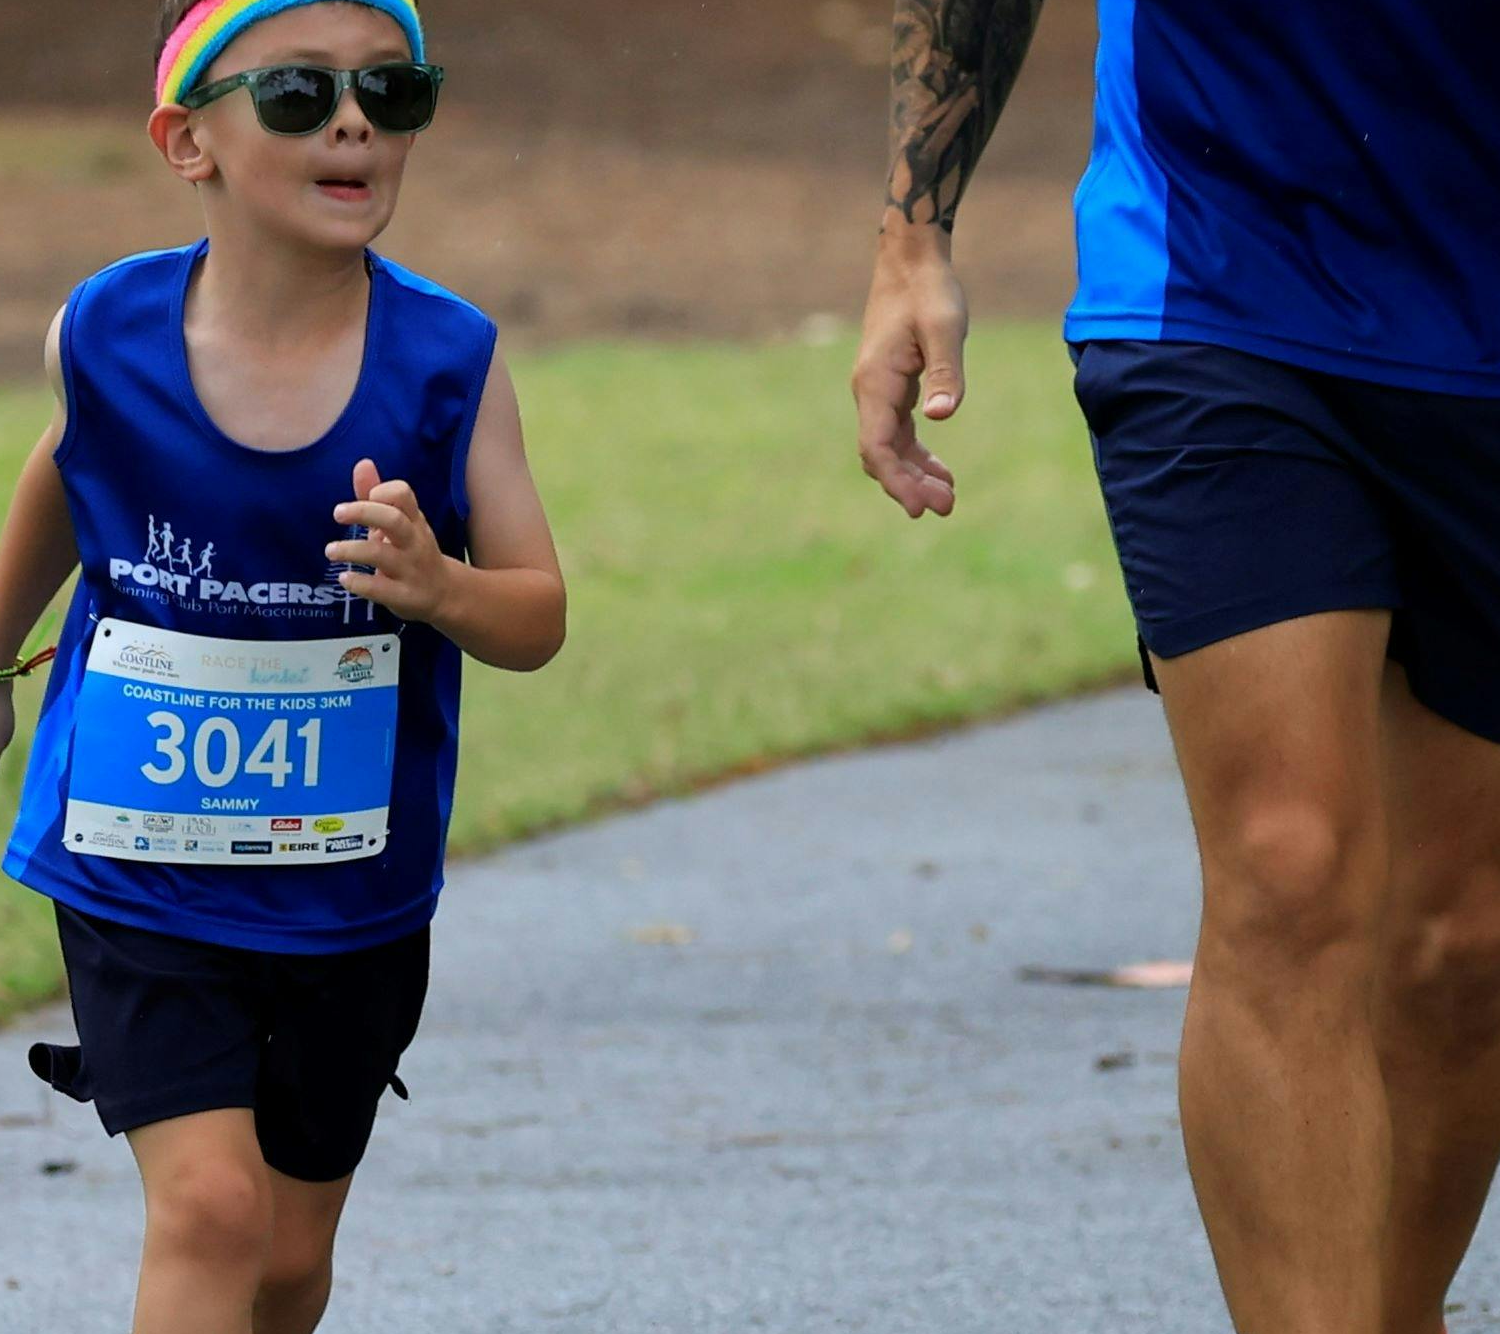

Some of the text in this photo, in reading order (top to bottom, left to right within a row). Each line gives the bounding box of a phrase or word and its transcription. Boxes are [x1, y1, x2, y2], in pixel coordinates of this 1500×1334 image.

[109, 557, 337, 605] PORT PACERS
[208, 600, 238, 615] Port
[243, 604, 336, 619] Macquarie
[120, 651, 174, 671] COASTLINE
[202, 655, 283, 669] RACE THE
[123, 683, 352, 710] COASTLINE FOR THE KIDS 3KM
[140, 711, 322, 788] 3041
[200, 797, 260, 811] SAMMY
[288, 842, 319, 851] EIRE
